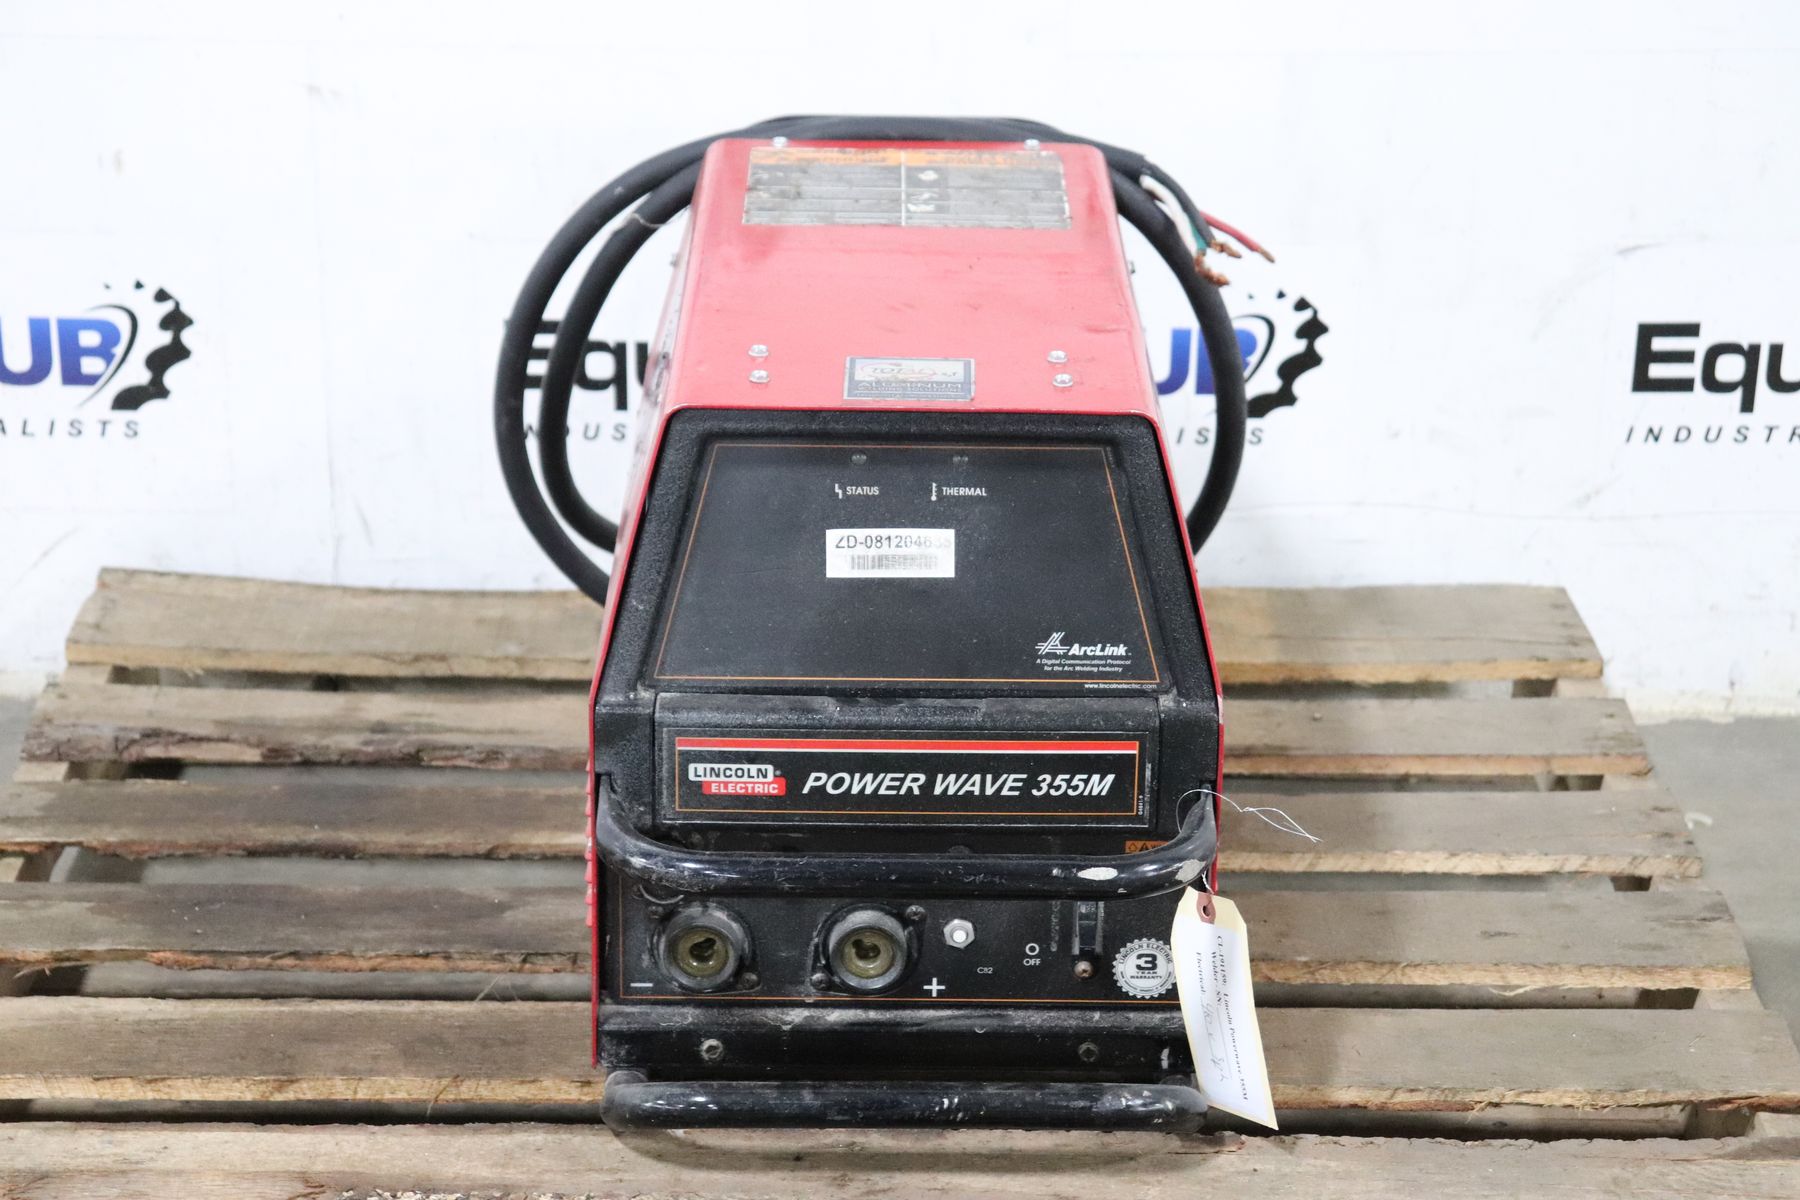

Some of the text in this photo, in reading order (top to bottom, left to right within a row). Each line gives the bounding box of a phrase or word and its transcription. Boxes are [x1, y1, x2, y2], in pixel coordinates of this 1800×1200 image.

[846, 486, 880, 496] STATUS
[941, 486, 988, 497] THERMAL
[1068, 643, 1128, 656] ArcLink
[693, 766, 769, 779] LINCOLN
[711, 783, 779, 794] ELECTRIC
[801, 771, 1115, 796] POWER WAVE 355M
[1023, 958, 1041, 966] OFF
[1135, 953, 1158, 971] 3
